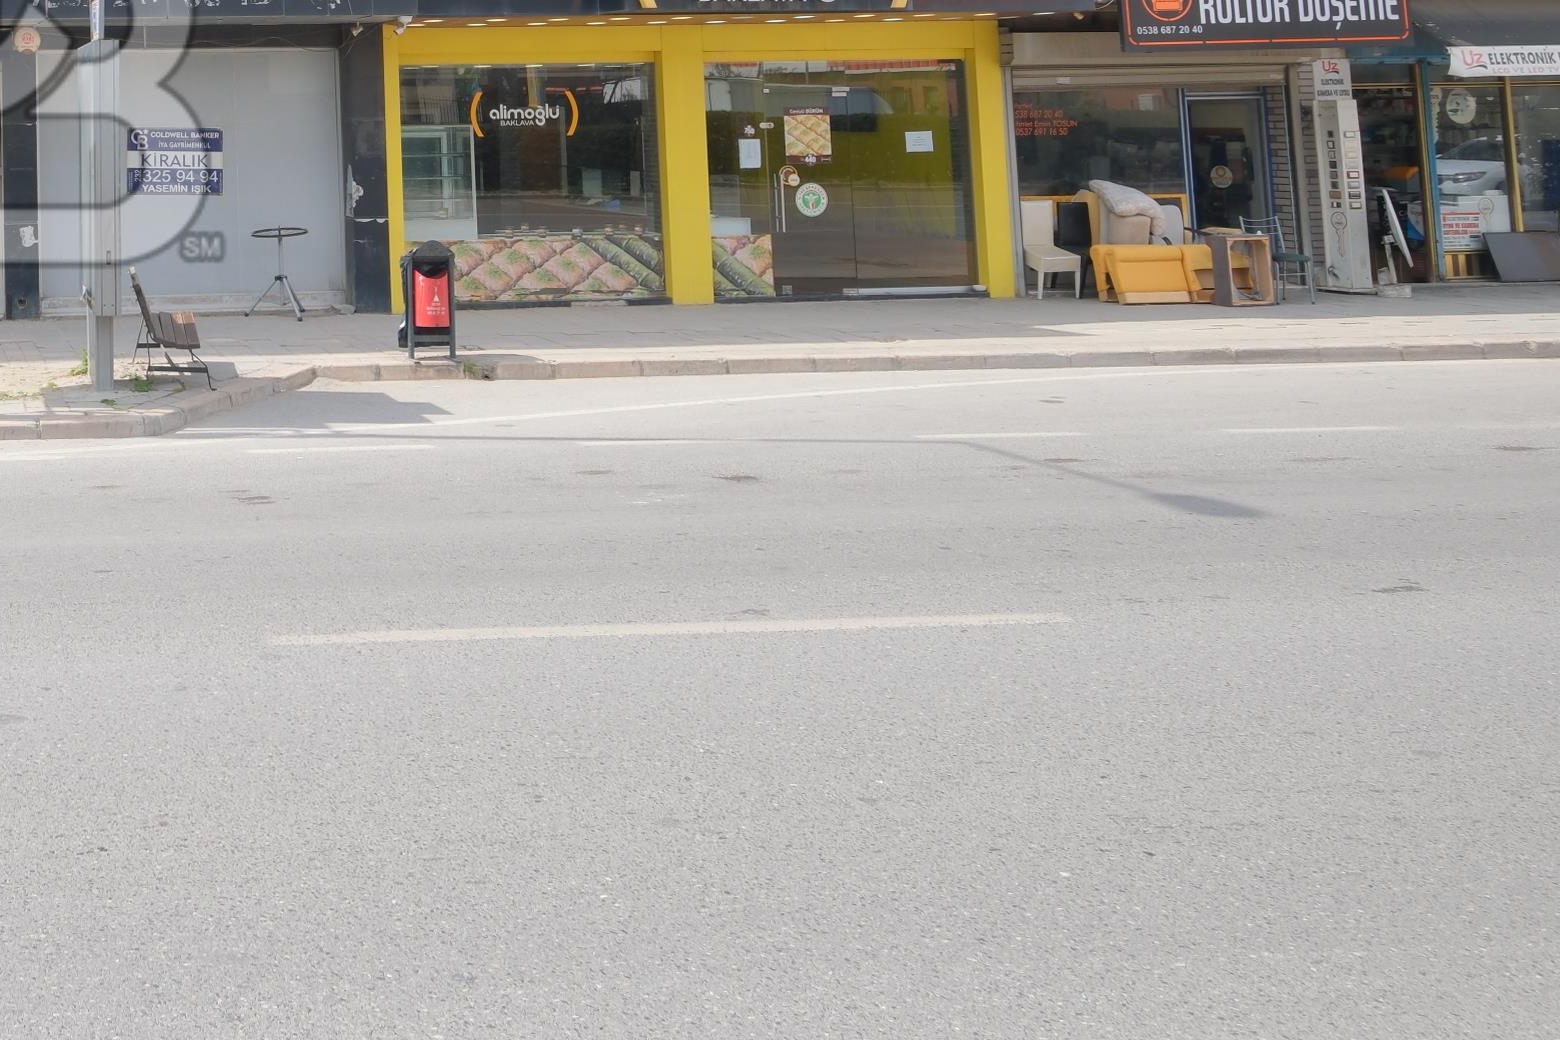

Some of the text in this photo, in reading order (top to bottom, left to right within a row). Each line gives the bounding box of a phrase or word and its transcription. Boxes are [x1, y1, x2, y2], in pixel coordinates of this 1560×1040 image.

[1136, 25, 1203, 35] 0538 687 20 40
[500, 119, 535, 127] BAKLAVA
[190, 131, 219, 139] BANKER
[142, 153, 208, 168] KİRALIK
[143, 170, 171, 183] 325
[176, 170, 194, 183] 94
[200, 171, 219, 183] 94
[143, 183, 187, 193] YASEMİN
